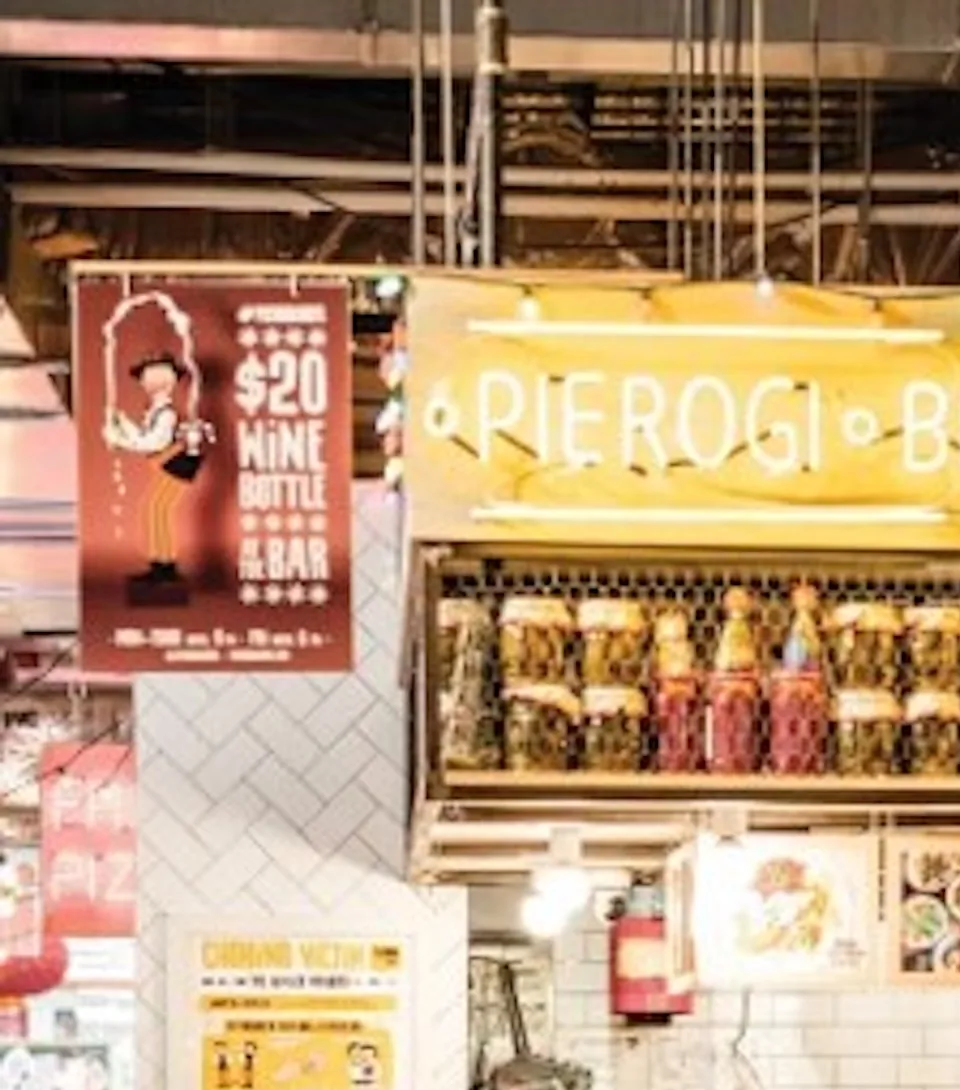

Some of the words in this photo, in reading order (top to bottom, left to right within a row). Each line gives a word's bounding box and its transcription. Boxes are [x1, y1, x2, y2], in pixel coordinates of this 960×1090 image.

[234, 350, 328, 417] $20
[478, 368, 822, 477] PIEROGI
[237, 472, 327, 511] BOTTLE
[267, 537, 330, 580] BAR
